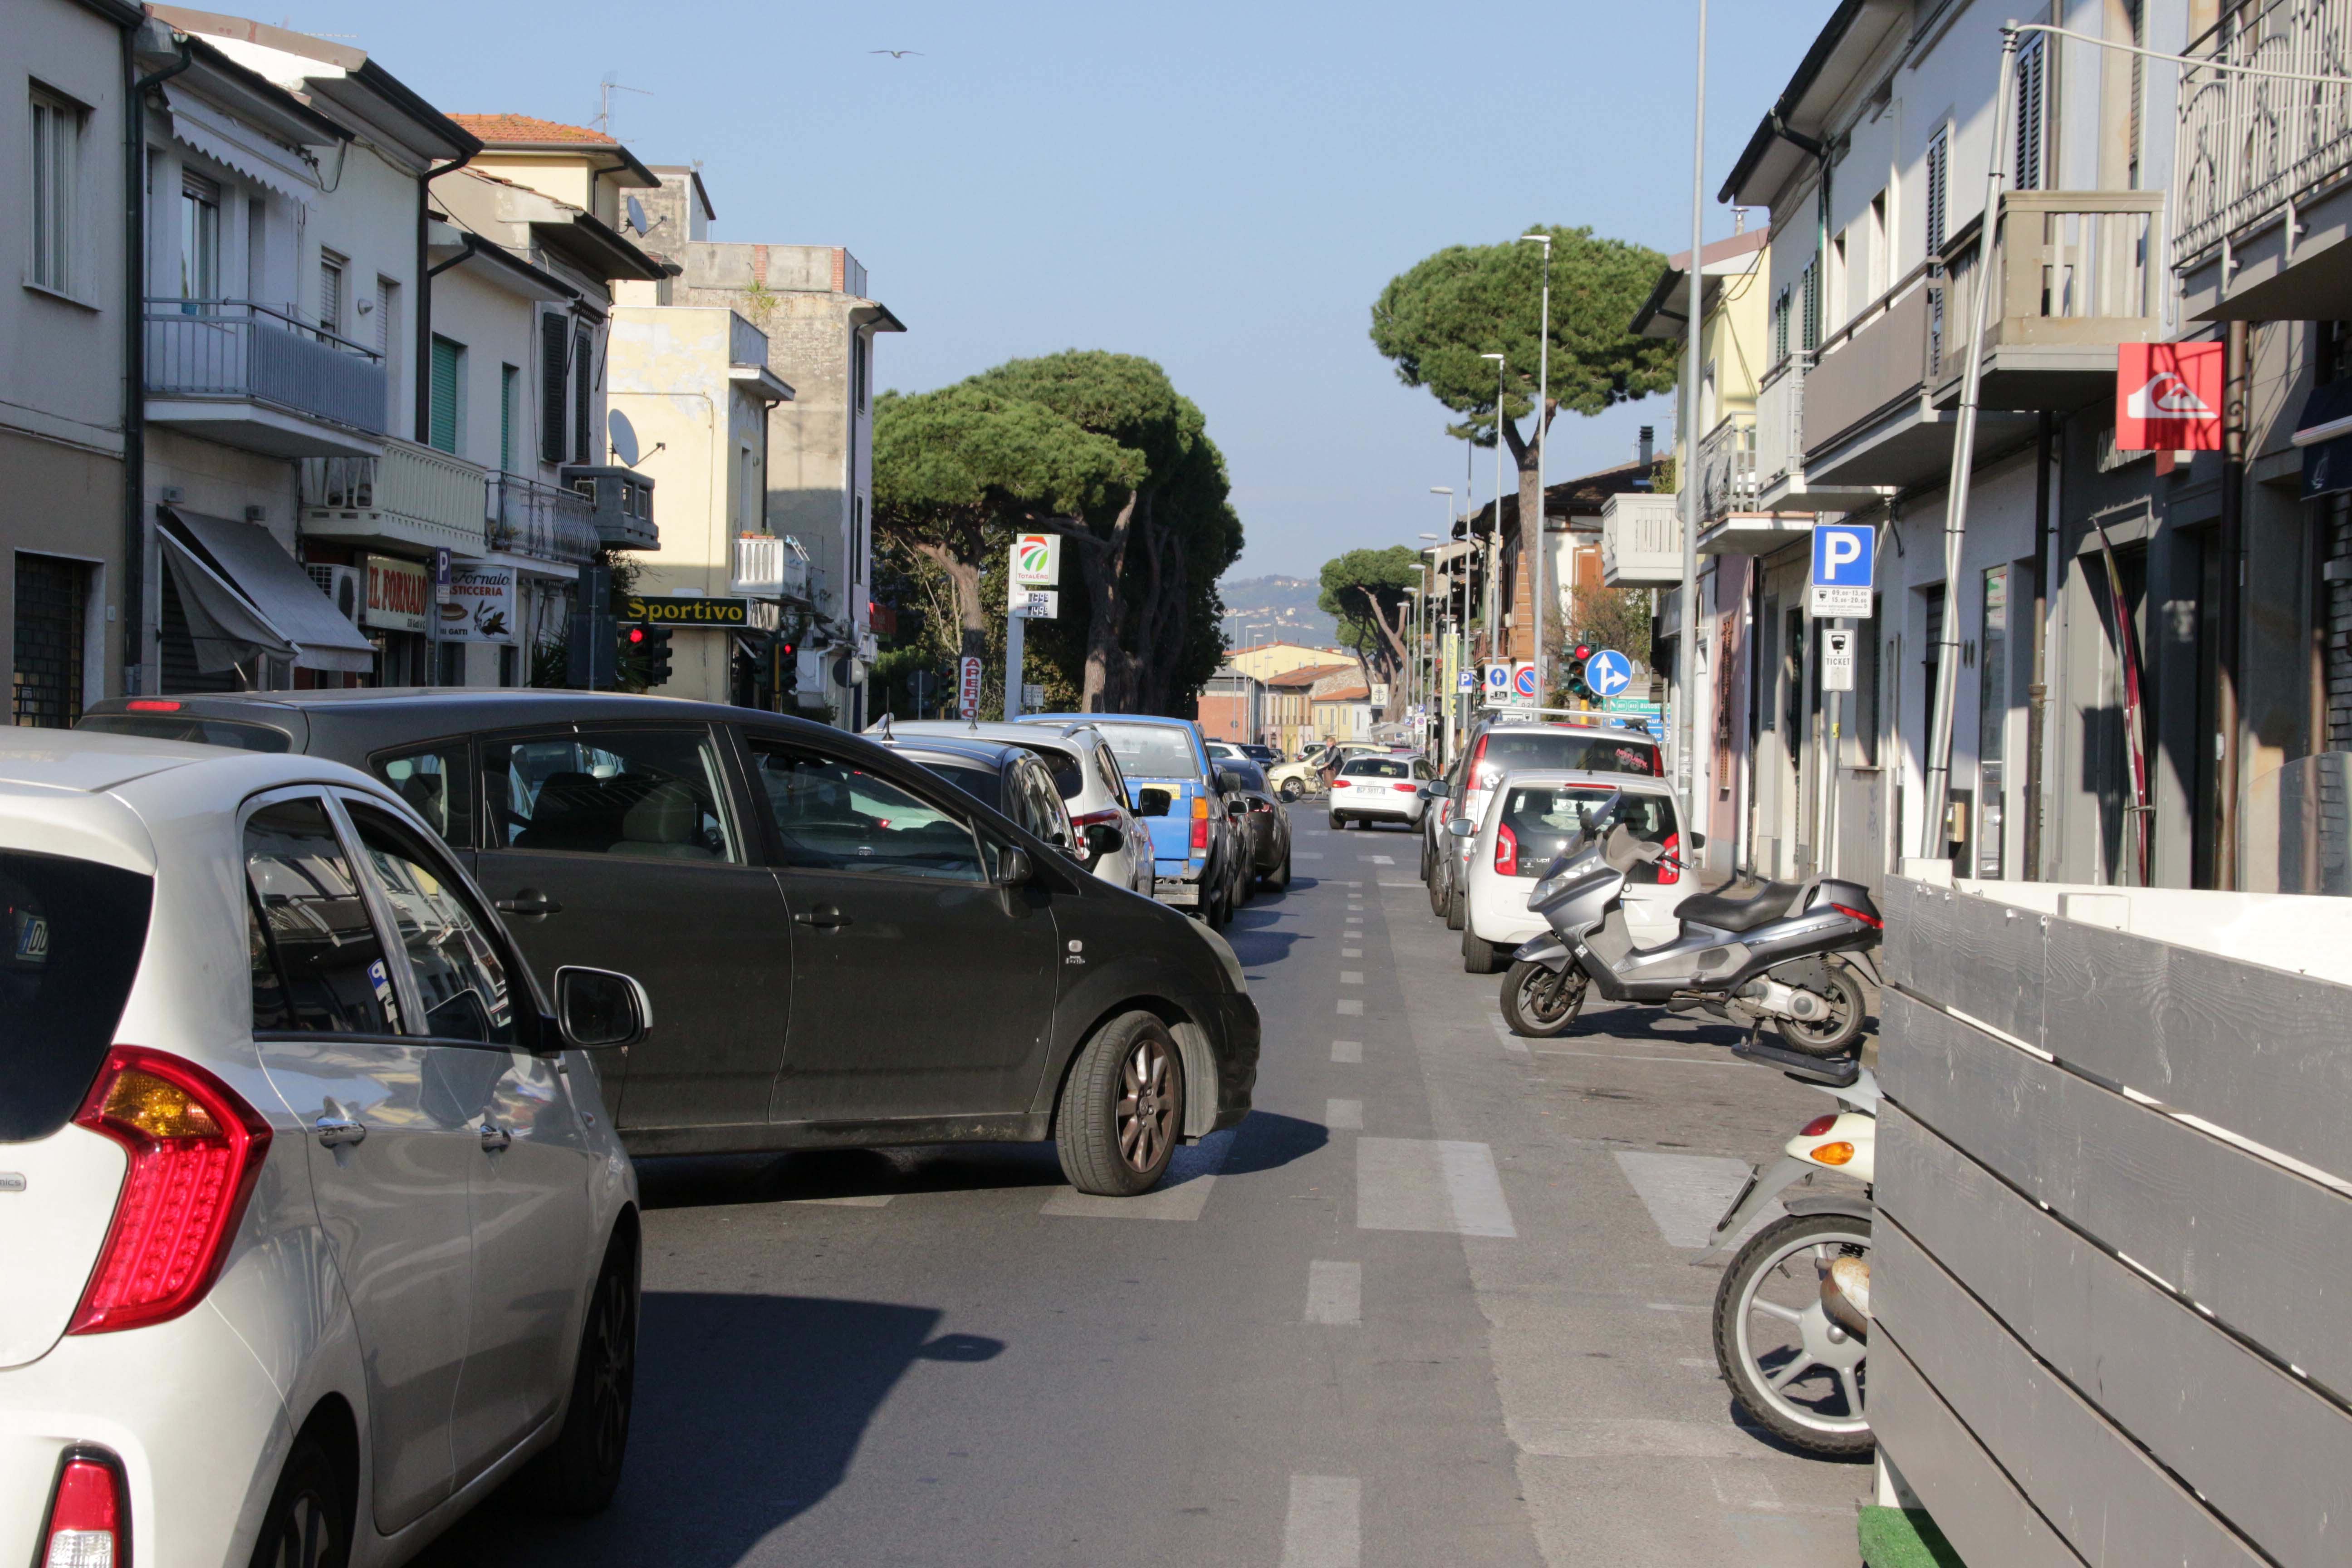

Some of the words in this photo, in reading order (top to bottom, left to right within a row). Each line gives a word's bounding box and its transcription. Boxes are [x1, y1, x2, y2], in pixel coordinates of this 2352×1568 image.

[439, 551, 448, 581] P
[1825, 532, 1861, 579] P
[368, 566, 379, 609] IL
[382, 569, 427, 616] FORNAIO
[450, 586, 504, 596] STICCERIA
[451, 570, 510, 585] Fornaio
[627, 598, 743, 622] Sportivo
[962, 658, 979, 718] APERTO
[1461, 673, 1470, 685] P
